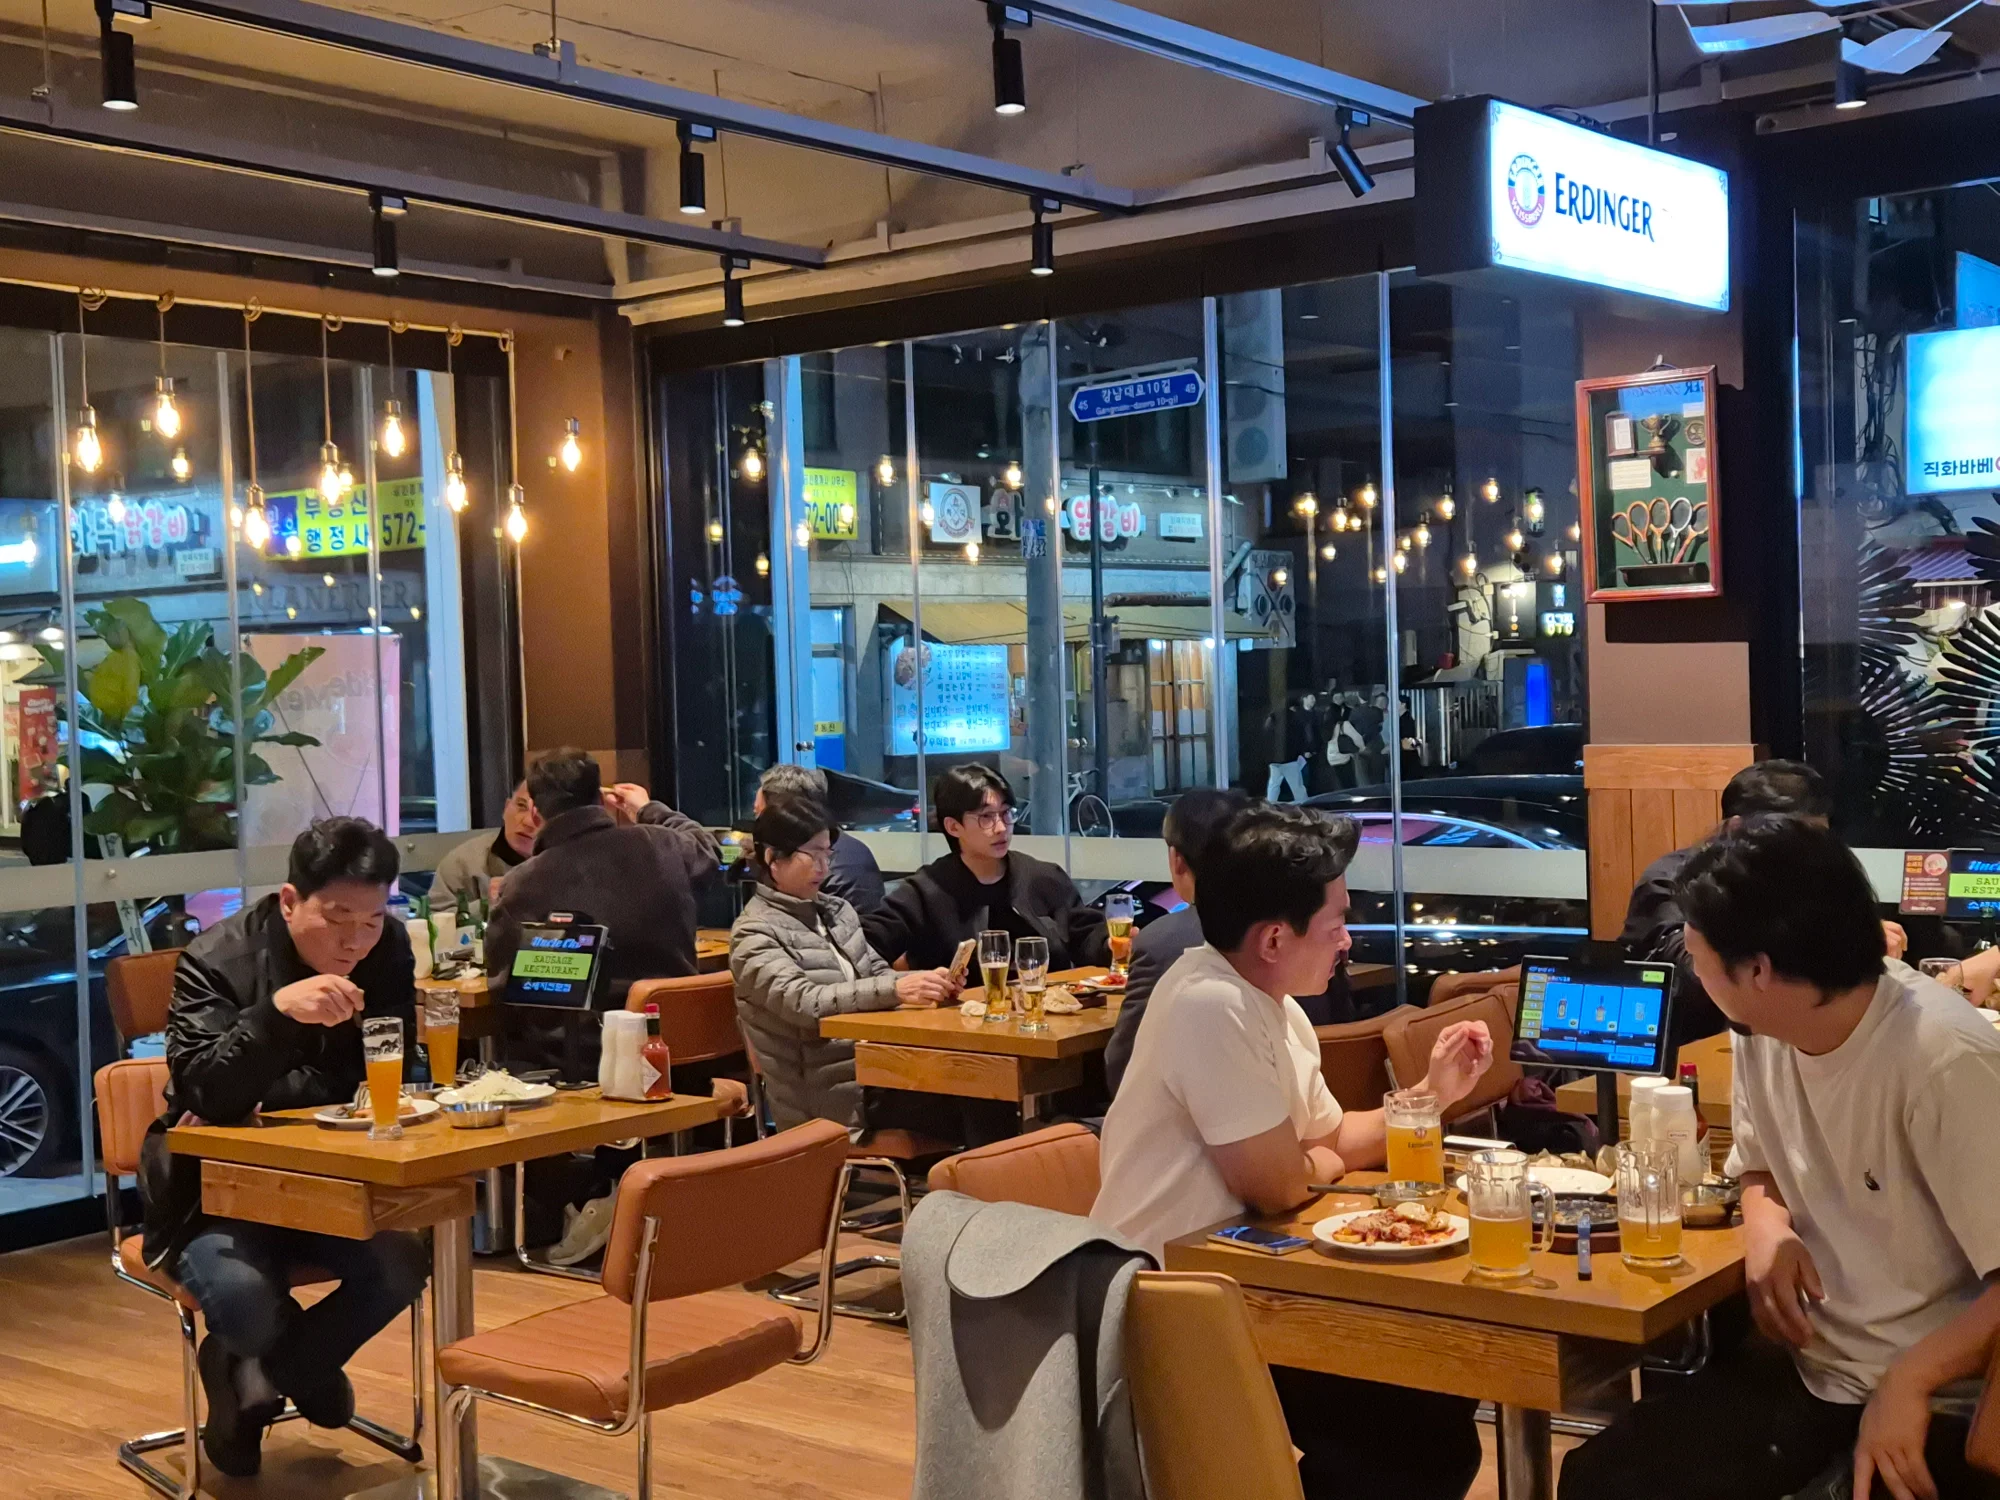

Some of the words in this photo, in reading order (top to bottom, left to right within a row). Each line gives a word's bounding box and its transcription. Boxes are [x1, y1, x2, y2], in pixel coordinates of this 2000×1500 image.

[1555, 172, 1655, 242] ERDINGER
[1102, 379, 1171, 403] 강남대로10길
[533, 954, 573, 965] SAUSAGE
[523, 964, 579, 976] RESTAURANT
